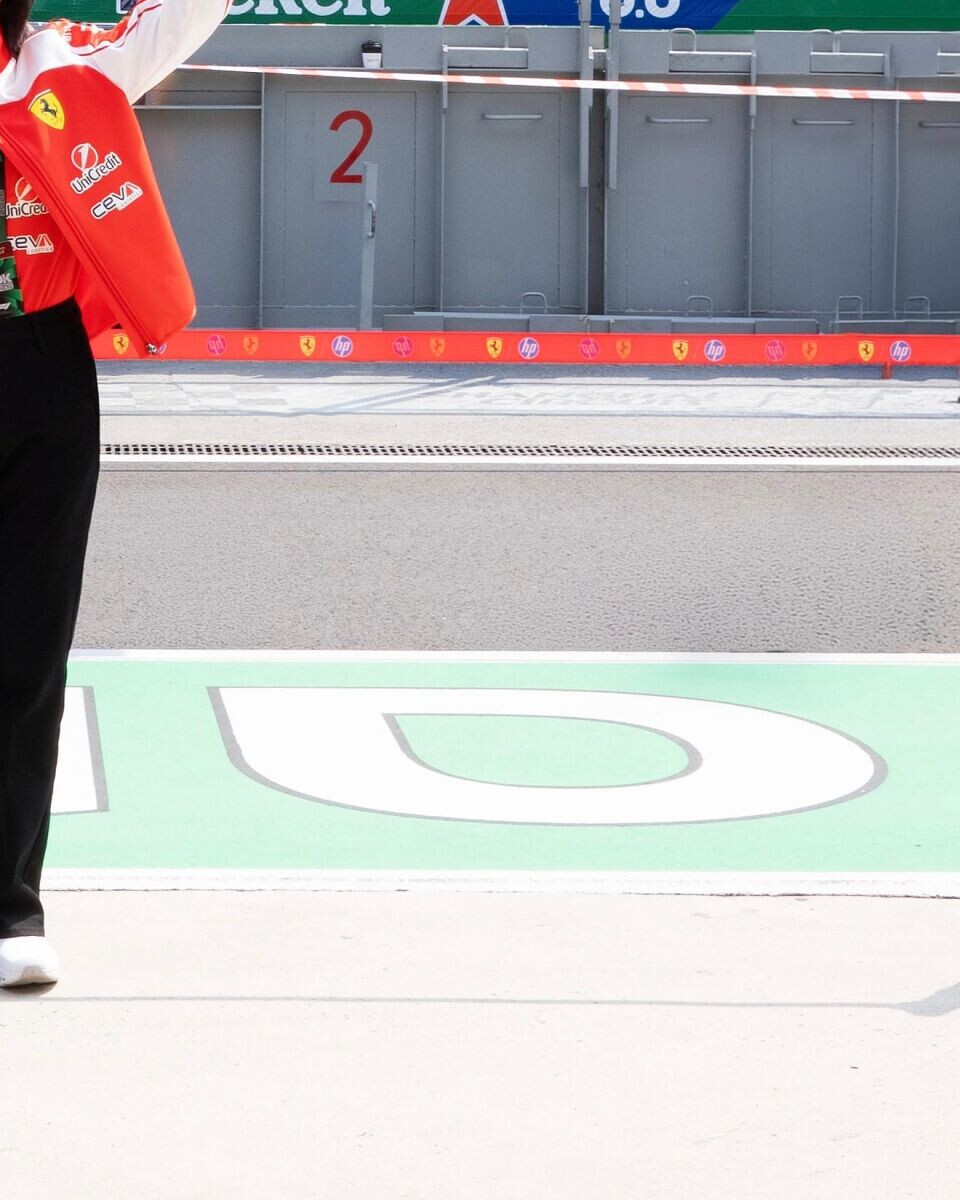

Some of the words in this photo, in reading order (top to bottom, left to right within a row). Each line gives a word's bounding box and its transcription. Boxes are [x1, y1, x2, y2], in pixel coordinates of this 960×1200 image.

[330, 110, 373, 183] 2
[71, 152, 121, 193] UniCredit
[333, 336, 352, 356] hp
[519, 338, 538, 359] hp
[705, 340, 725, 361] hp
[891, 341, 910, 362] hp
